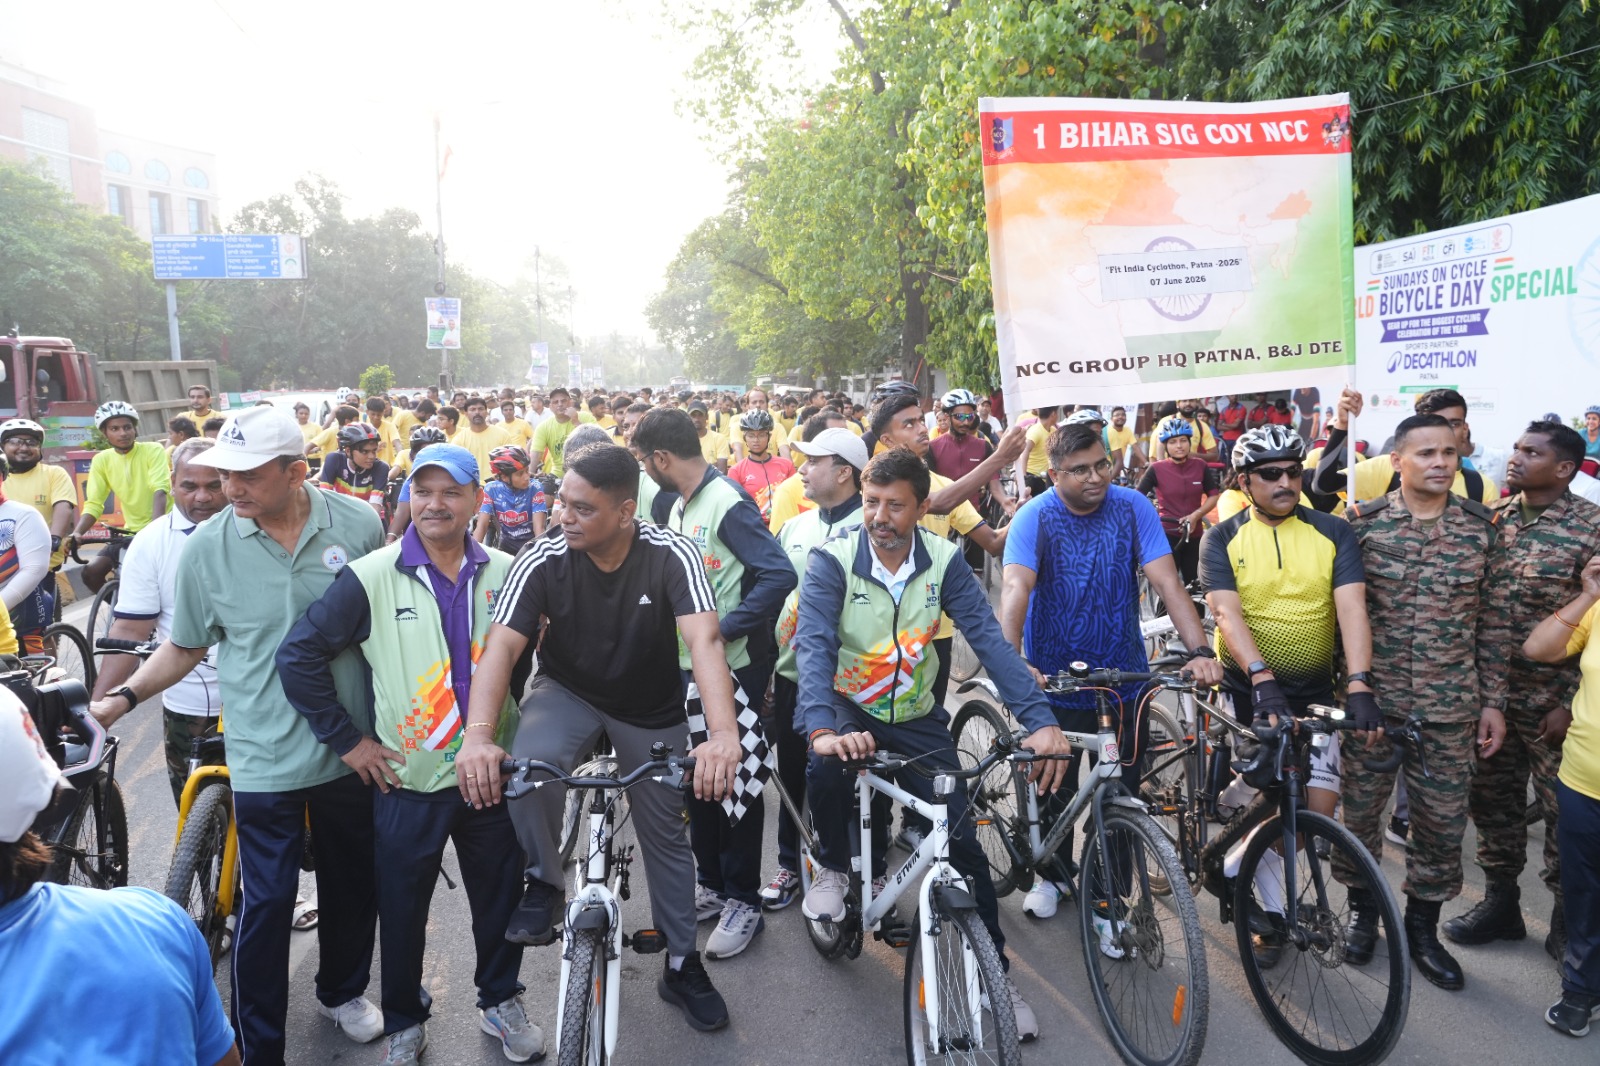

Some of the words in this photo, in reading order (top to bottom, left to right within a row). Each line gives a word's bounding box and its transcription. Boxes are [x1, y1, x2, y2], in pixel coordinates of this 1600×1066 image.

[1033, 124, 1046, 149] 1
[1060, 122, 1149, 148] BIHAR
[1155, 122, 1199, 145] SIG
[1204, 122, 1254, 144] COY
[1260, 120, 1309, 142] NCC
[1443, 244, 1455, 255] CFI
[1147, 262, 1189, 273] Cyclothon,
[1384, 270, 1428, 290] SUNDAYS
[1433, 266, 1446, 283] ON
[1451, 260, 1487, 280] CYCLE
[1185, 276, 1206, 284] 2026
[1355, 295, 1374, 319] LD
[1379, 285, 1442, 316] BICYCLE
[1451, 278, 1484, 307] DAY
[1490, 266, 1578, 303] SPECIAL
[1387, 322, 1400, 331] GEAR
[1409, 321, 1419, 329] FOR
[1432, 316, 1455, 326] BIGGEST
[1456, 313, 1481, 324] CYCLING
[1397, 329, 1431, 339] CELEBRATION
[1441, 327, 1451, 335] THE
[1453, 325, 1468, 333] YEAR
[1405, 343, 1428, 351] SPORTS
[1430, 340, 1458, 349] PARTNER
[1016, 361, 1060, 378] NCC
[1068, 355, 1150, 374] GROUP
[1158, 352, 1187, 368] HQ
[1195, 348, 1261, 364] PATNA,
[1268, 344, 1302, 359] B&J
[1309, 341, 1342, 355] DTE
[1403, 350, 1477, 370] DECATHLON
[693, 525, 708, 538] FIT
